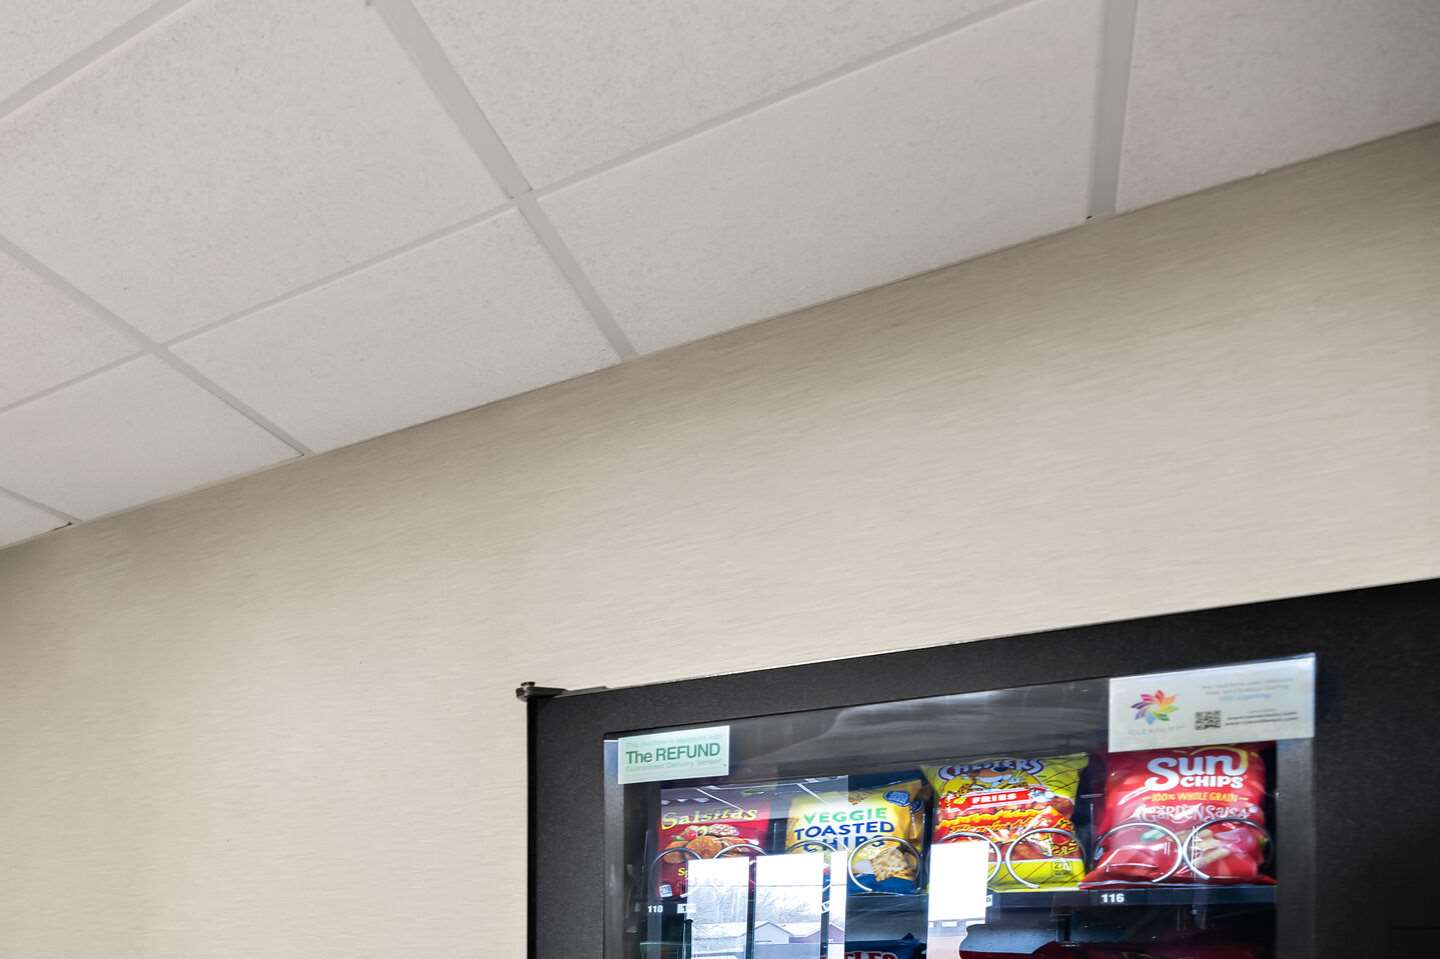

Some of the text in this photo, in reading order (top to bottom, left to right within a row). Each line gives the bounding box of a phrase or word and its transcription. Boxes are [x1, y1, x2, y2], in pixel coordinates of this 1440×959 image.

[625, 742, 721, 765] The REFUND
[1143, 755, 1249, 791] Sun
[1179, 775, 1245, 789] CHIPS
[971, 793, 1017, 805] FRIES
[803, 807, 888, 824] VEGGIE
[793, 821, 895, 841] TOASTED
[1101, 893, 1125, 903] 116
[647, 905, 663, 913] 110
